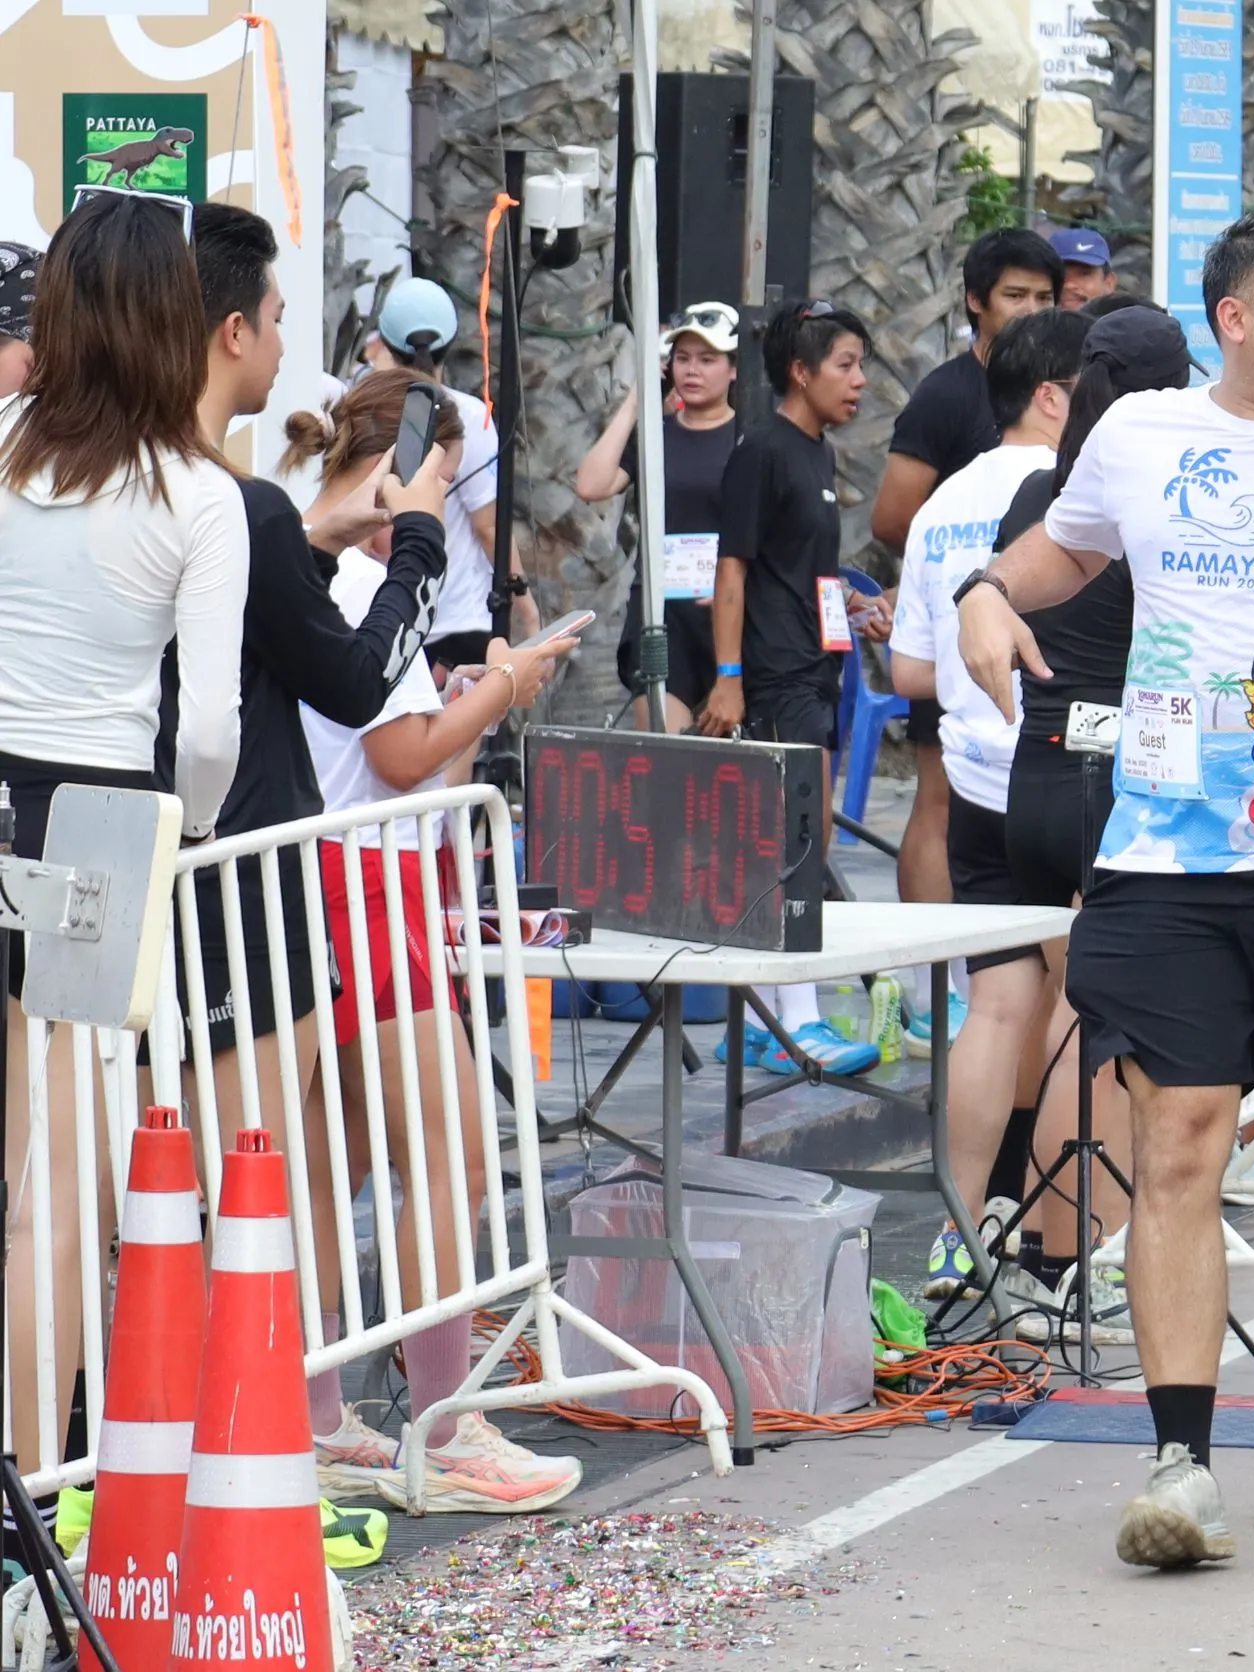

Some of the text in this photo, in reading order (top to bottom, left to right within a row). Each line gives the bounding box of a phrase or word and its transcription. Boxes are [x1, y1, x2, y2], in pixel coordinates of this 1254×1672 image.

[86, 117, 157, 131] PATTAYA
[1197, 575, 1230, 587] RUN
[1170, 696, 1193, 716] 5K
[1138, 730, 1167, 750] Guest
[171, 1588, 306, 1670] ทต.ห้วยใหญ่
